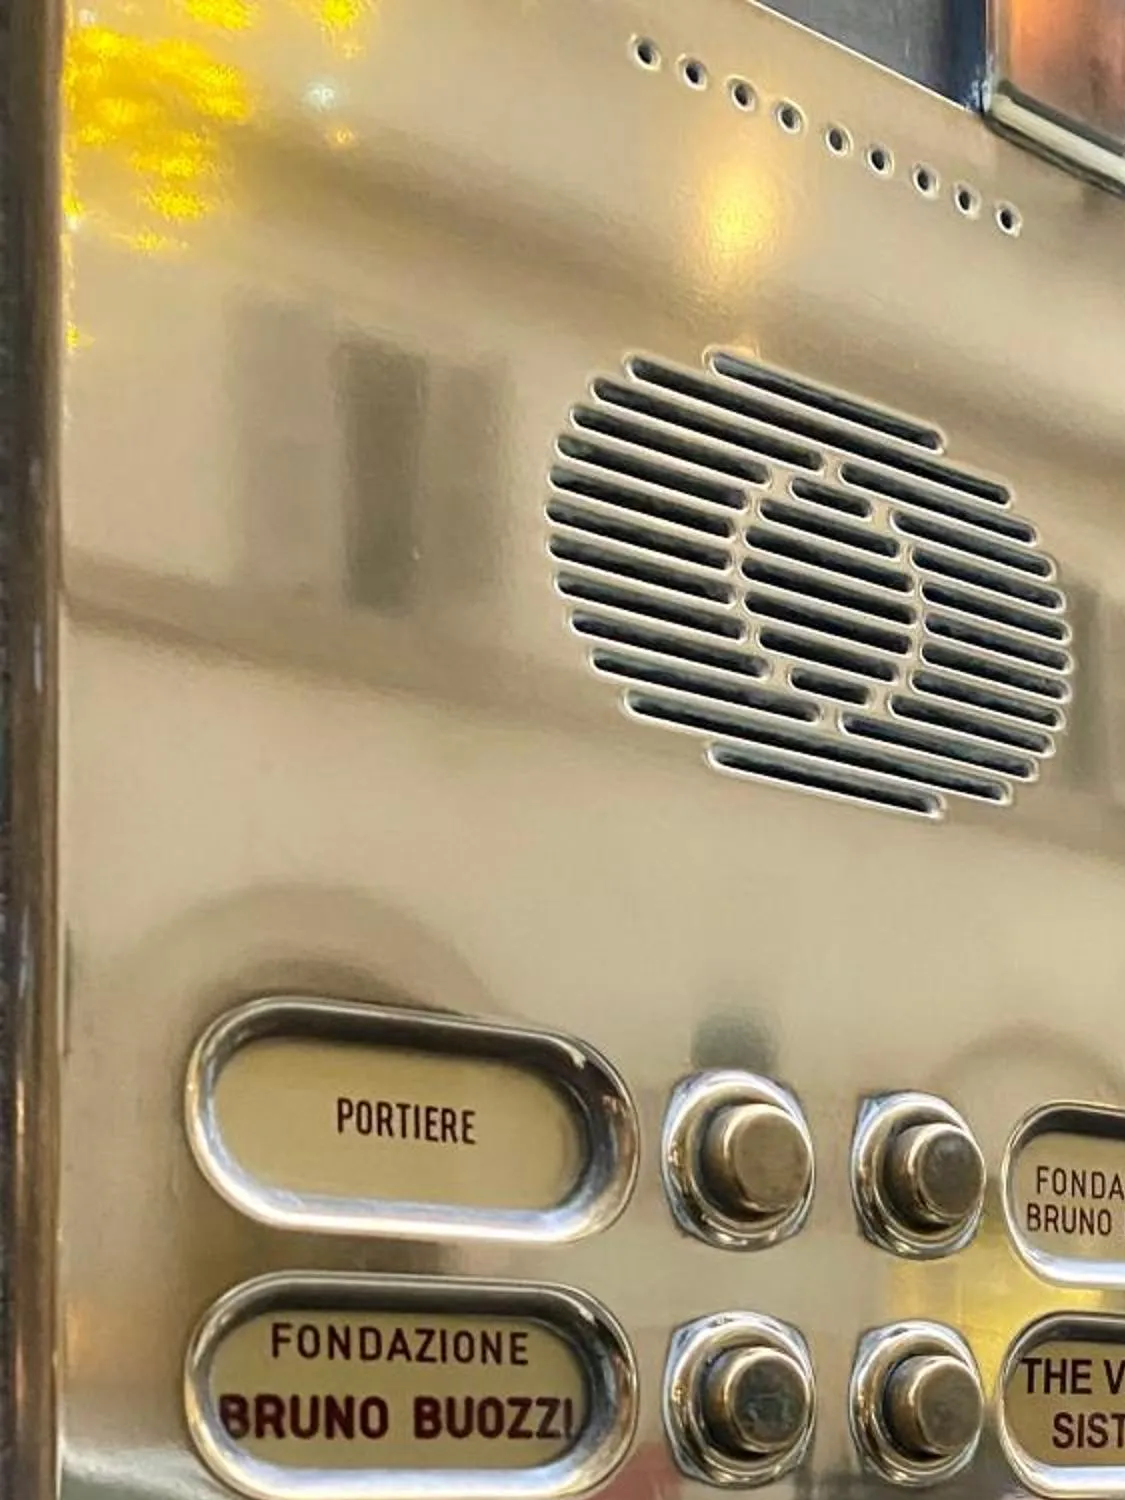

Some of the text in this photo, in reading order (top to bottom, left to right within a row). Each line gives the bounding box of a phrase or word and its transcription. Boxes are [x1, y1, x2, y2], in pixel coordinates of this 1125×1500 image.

[337, 1097, 477, 1144] PORTIERE
[1027, 1203, 1112, 1236] BRUNO
[271, 1322, 529, 1365] FONDAZIONE
[1022, 1358, 1092, 1395] THE
[219, 1394, 574, 1440] BRUNO BUOZZI
